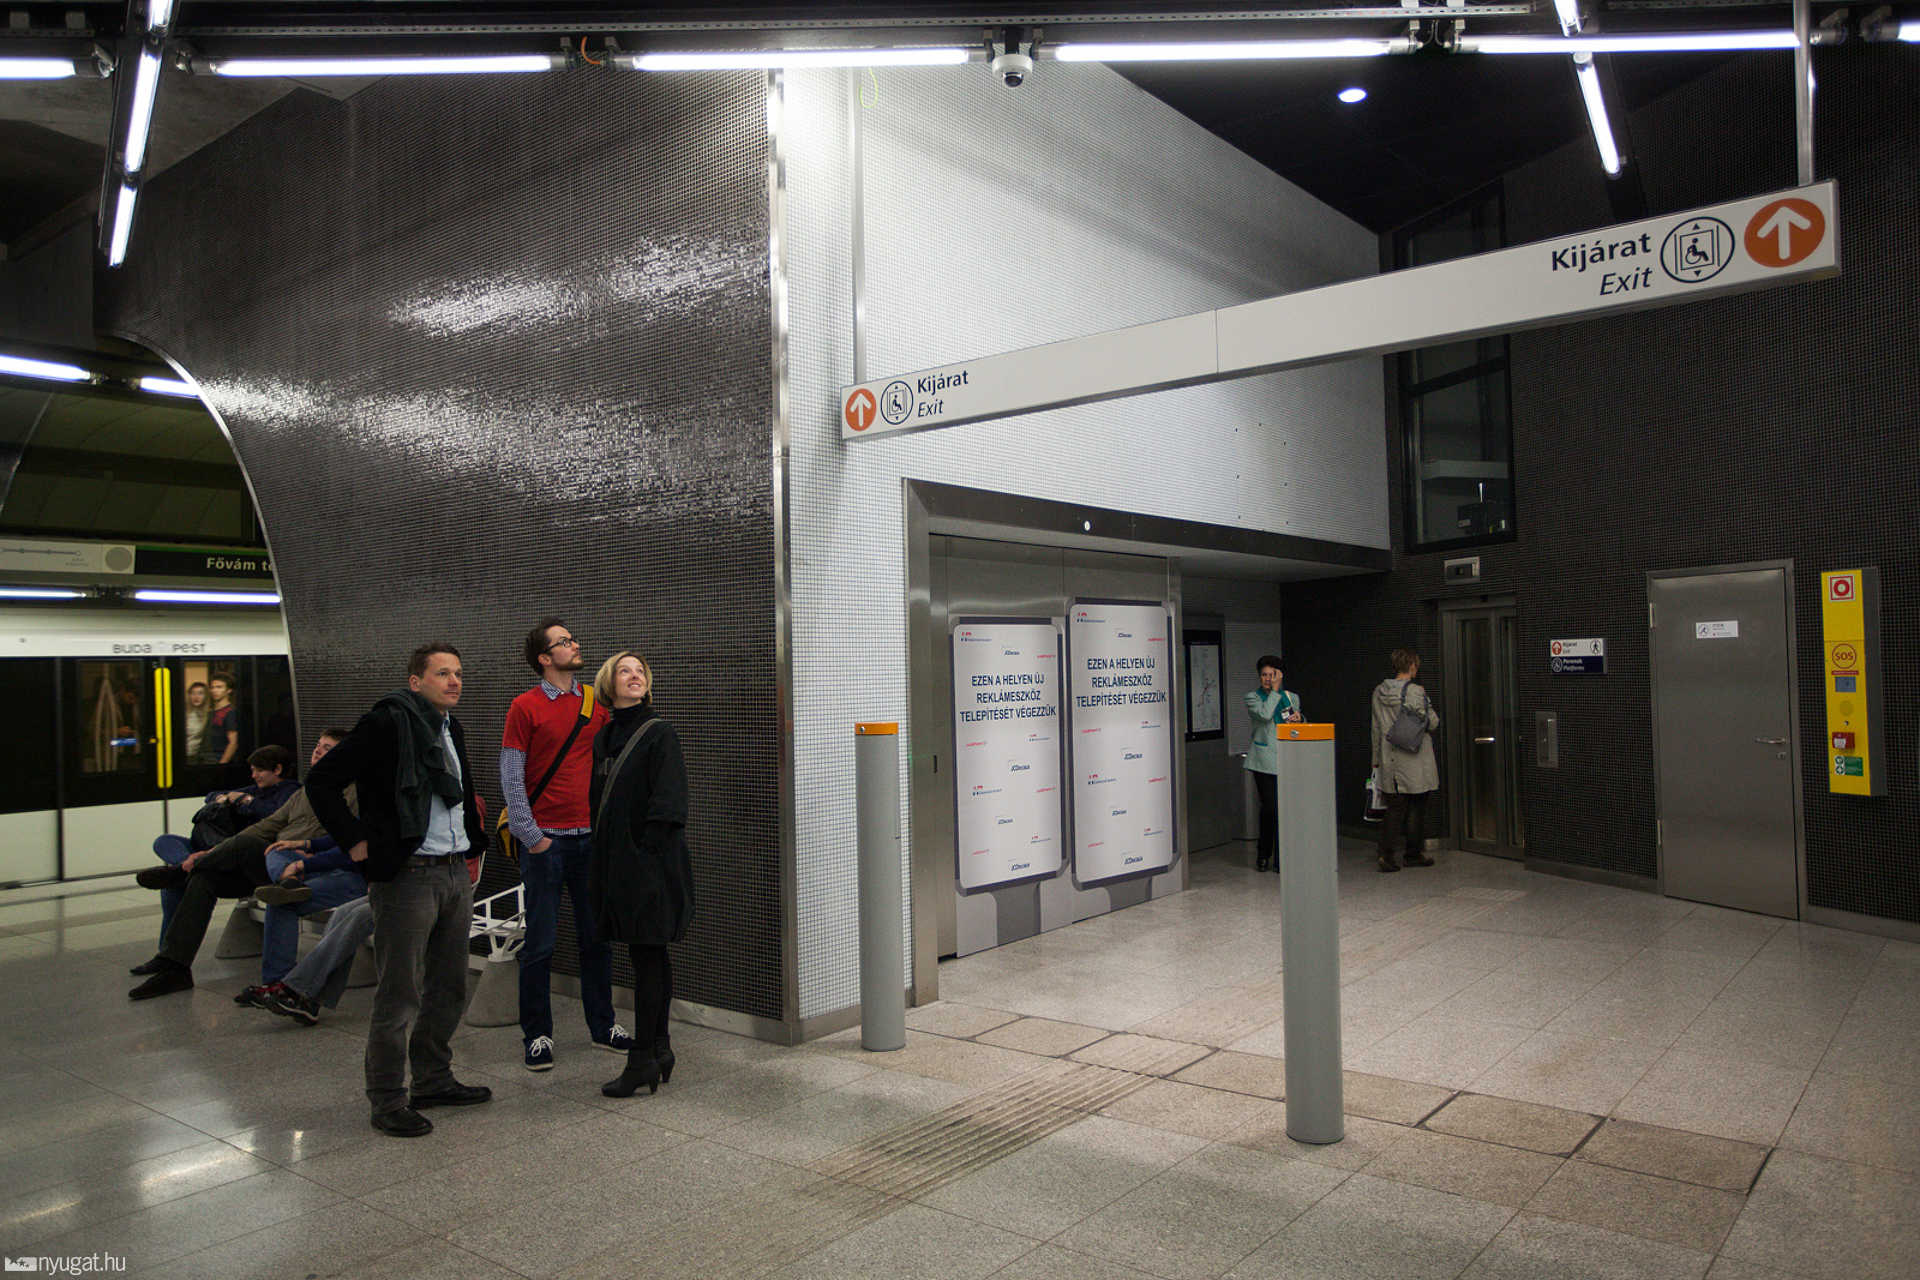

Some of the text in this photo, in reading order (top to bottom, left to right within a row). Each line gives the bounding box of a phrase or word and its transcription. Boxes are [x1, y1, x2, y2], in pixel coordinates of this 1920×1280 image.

[1551, 232, 1652, 272] Kijárat
[1599, 267, 1653, 296] Exit
[917, 370, 968, 395] Kijárat
[917, 399, 944, 418] Exit
[1087, 656, 1155, 670] EZEN A HELYEN ÚJ
[1835, 651, 1853, 661] SOS
[971, 672, 1045, 687] EZEN A HELYEN ÚJ
[1091, 673, 1152, 688] REKLÁMESZKÖZ
[976, 688, 1041, 704] REKLÁMESZKÖZ
